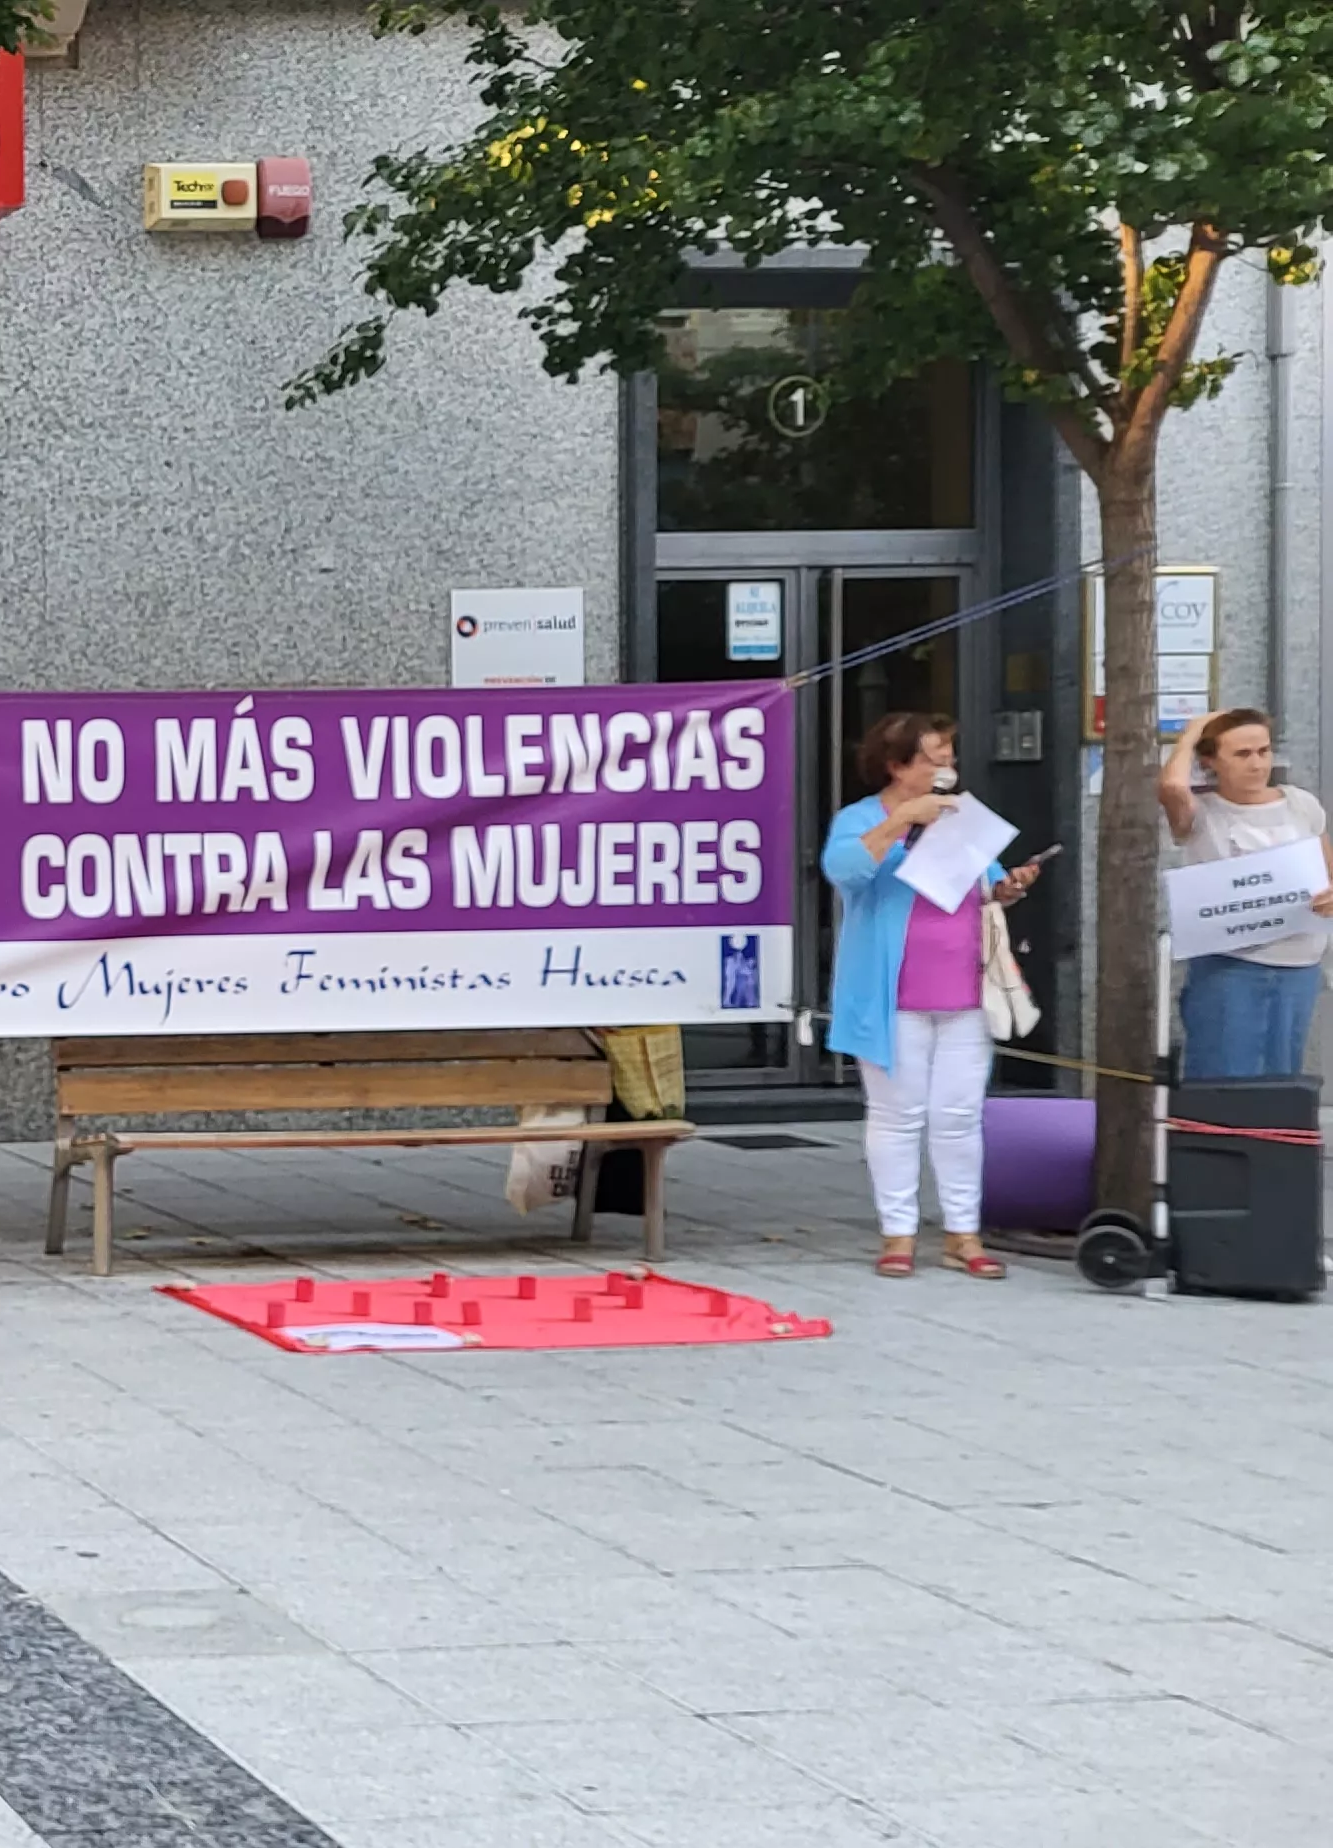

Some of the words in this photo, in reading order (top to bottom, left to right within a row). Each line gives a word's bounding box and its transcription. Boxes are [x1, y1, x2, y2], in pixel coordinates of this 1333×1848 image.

[788, 387, 805, 426] 1
[21, 717, 126, 804] NO
[154, 694, 315, 803] MÁS
[340, 707, 766, 800] VIOLENCIAS
[20, 831, 289, 919] CONTRA
[307, 828, 432, 912] LAS
[450, 818, 763, 909] MUJERES
[1232, 871, 1274, 889] NOS
[1199, 888, 1312, 919] QUEREMOS
[57, 950, 249, 1026] Mujeres
[279, 949, 512, 995] Feministas
[539, 944, 688, 988] Huesca
